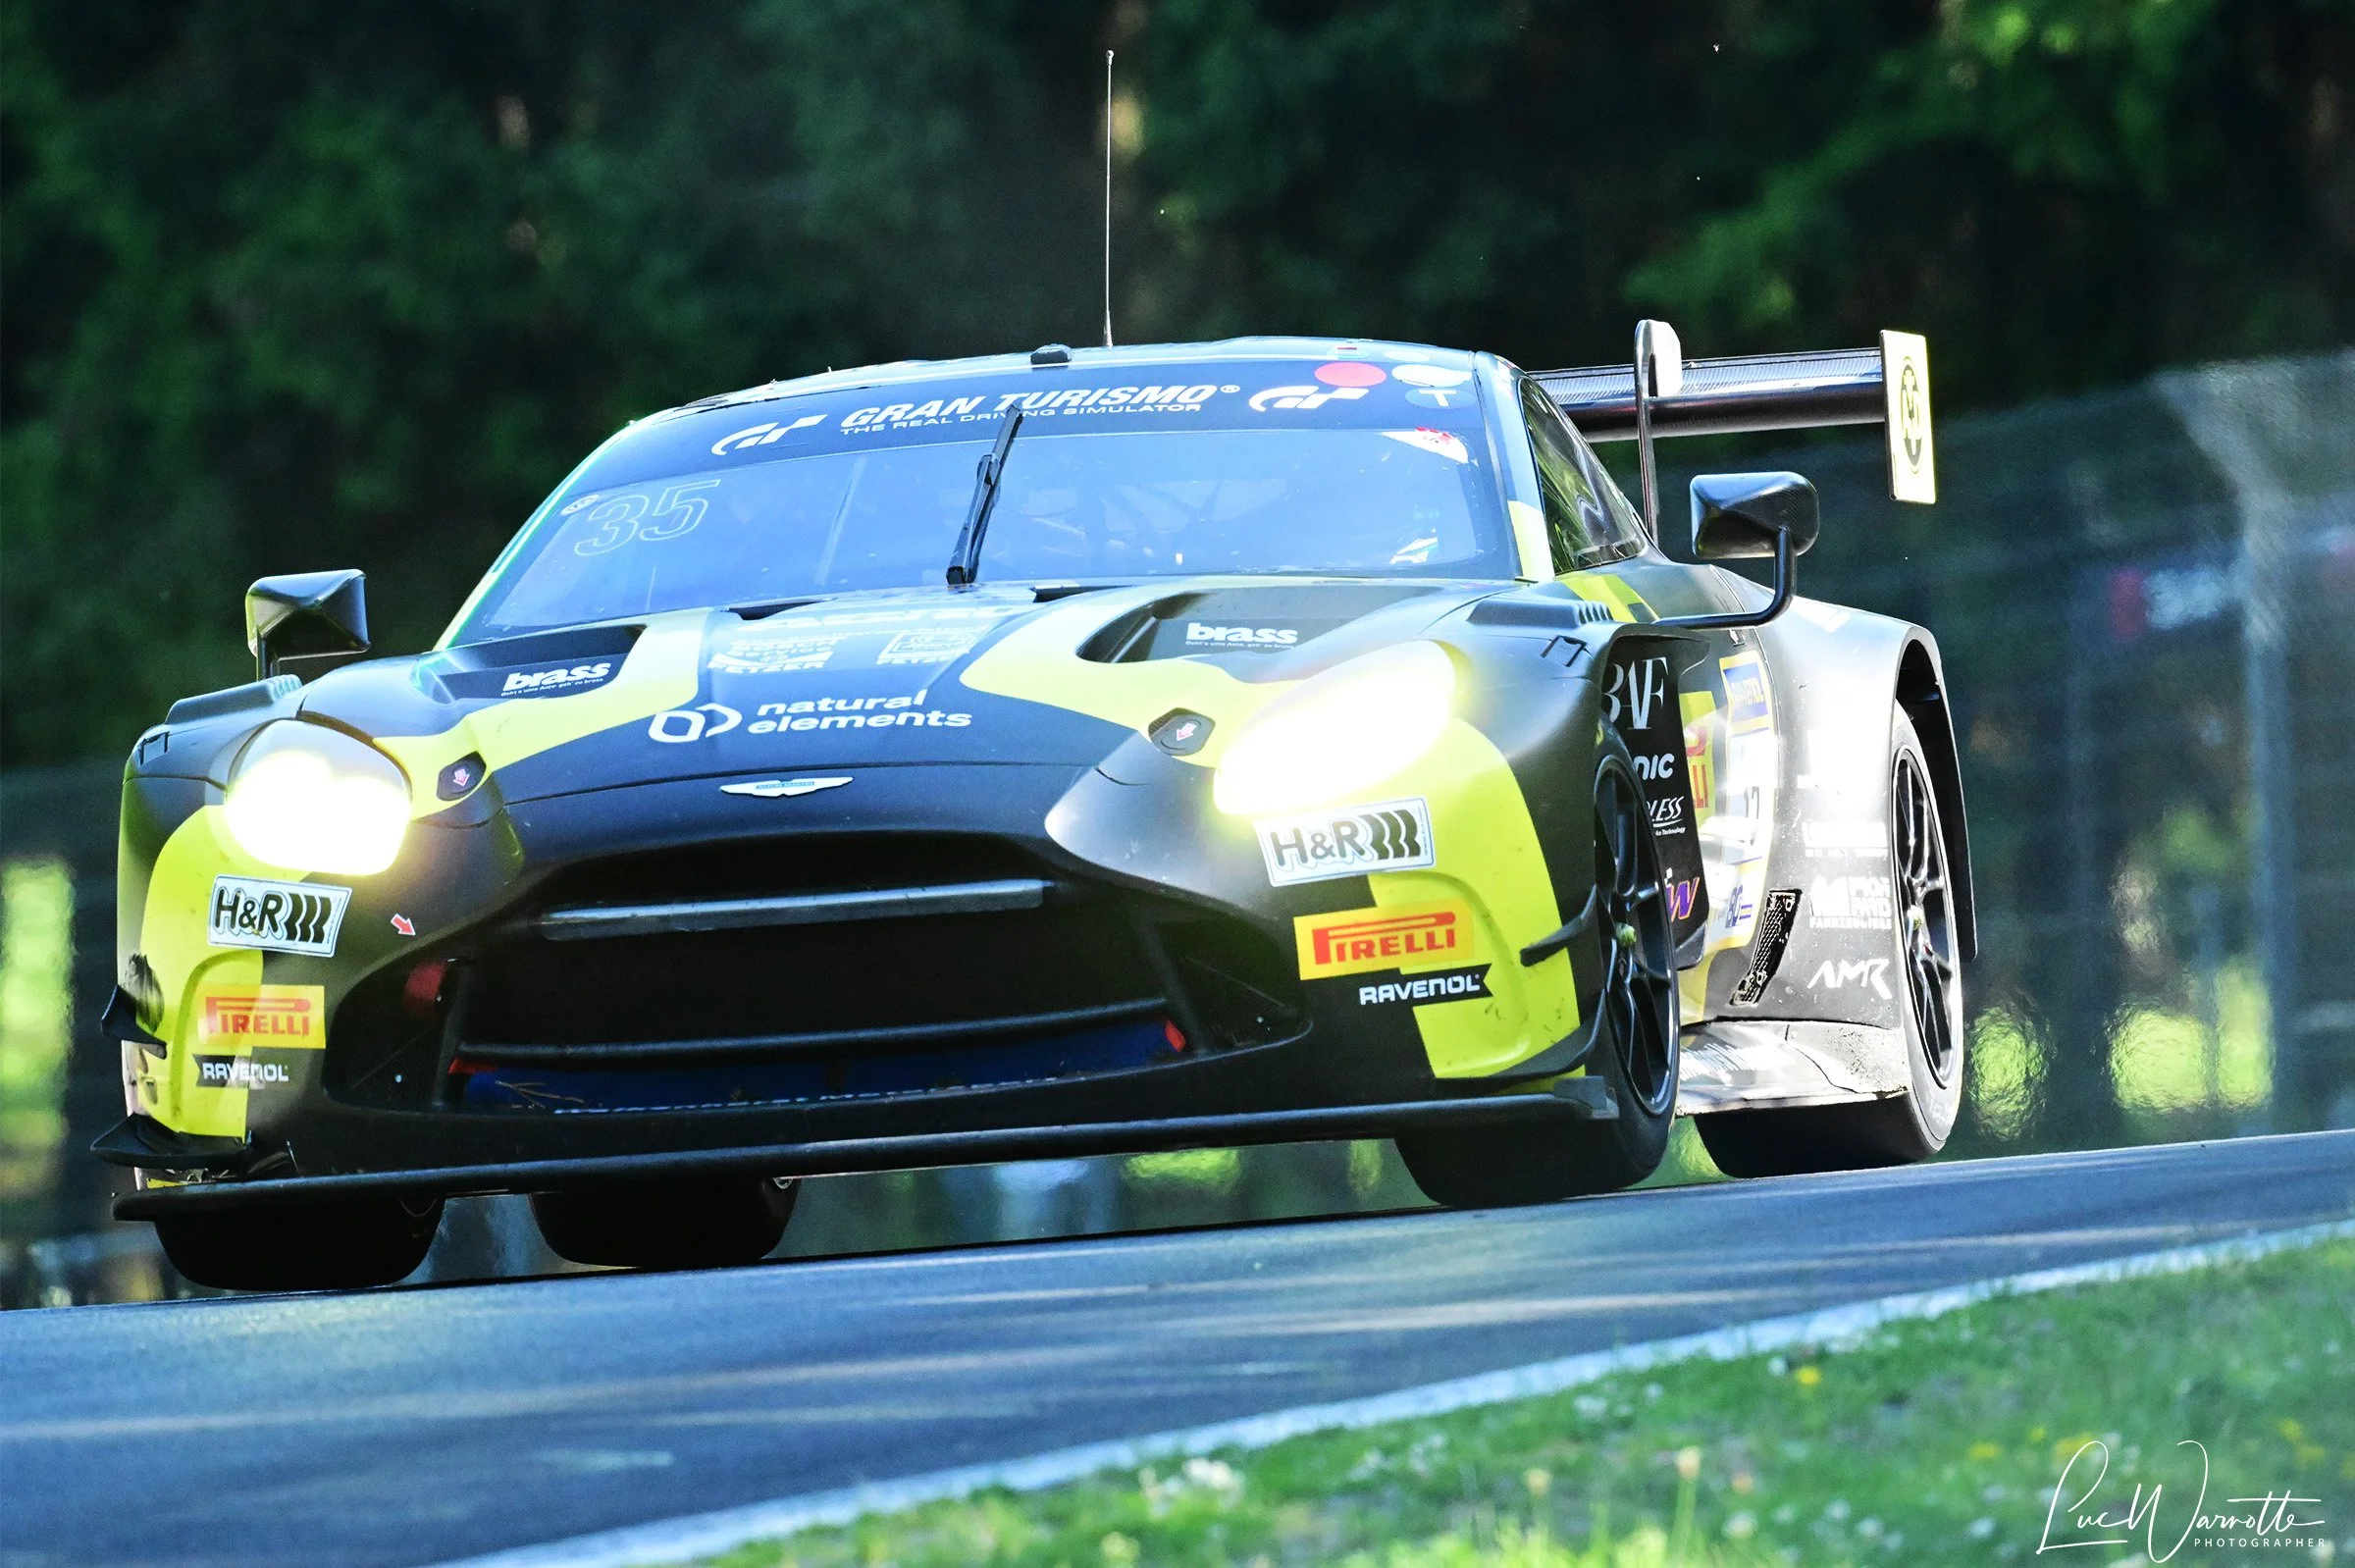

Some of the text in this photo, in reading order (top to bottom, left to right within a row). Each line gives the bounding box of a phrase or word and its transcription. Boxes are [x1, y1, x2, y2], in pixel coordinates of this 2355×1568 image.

[840, 395, 986, 429] GRAN
[840, 424, 885, 436] THE
[893, 416, 953, 429] REAL
[1063, 403, 1201, 415] SIMULATOR
[573, 479, 722, 556] 35
[1186, 622, 1298, 644] brass
[502, 662, 611, 691] brass
[758, 689, 928, 716] natural
[748, 709, 973, 734] elements
[214, 887, 285, 934] H&R
[1312, 912, 1456, 966] PIRELLI
[1359, 974, 1480, 1006] RAVENOL
[205, 996, 312, 1037] PIRELLI
[202, 1062, 290, 1082] RAVENOL
